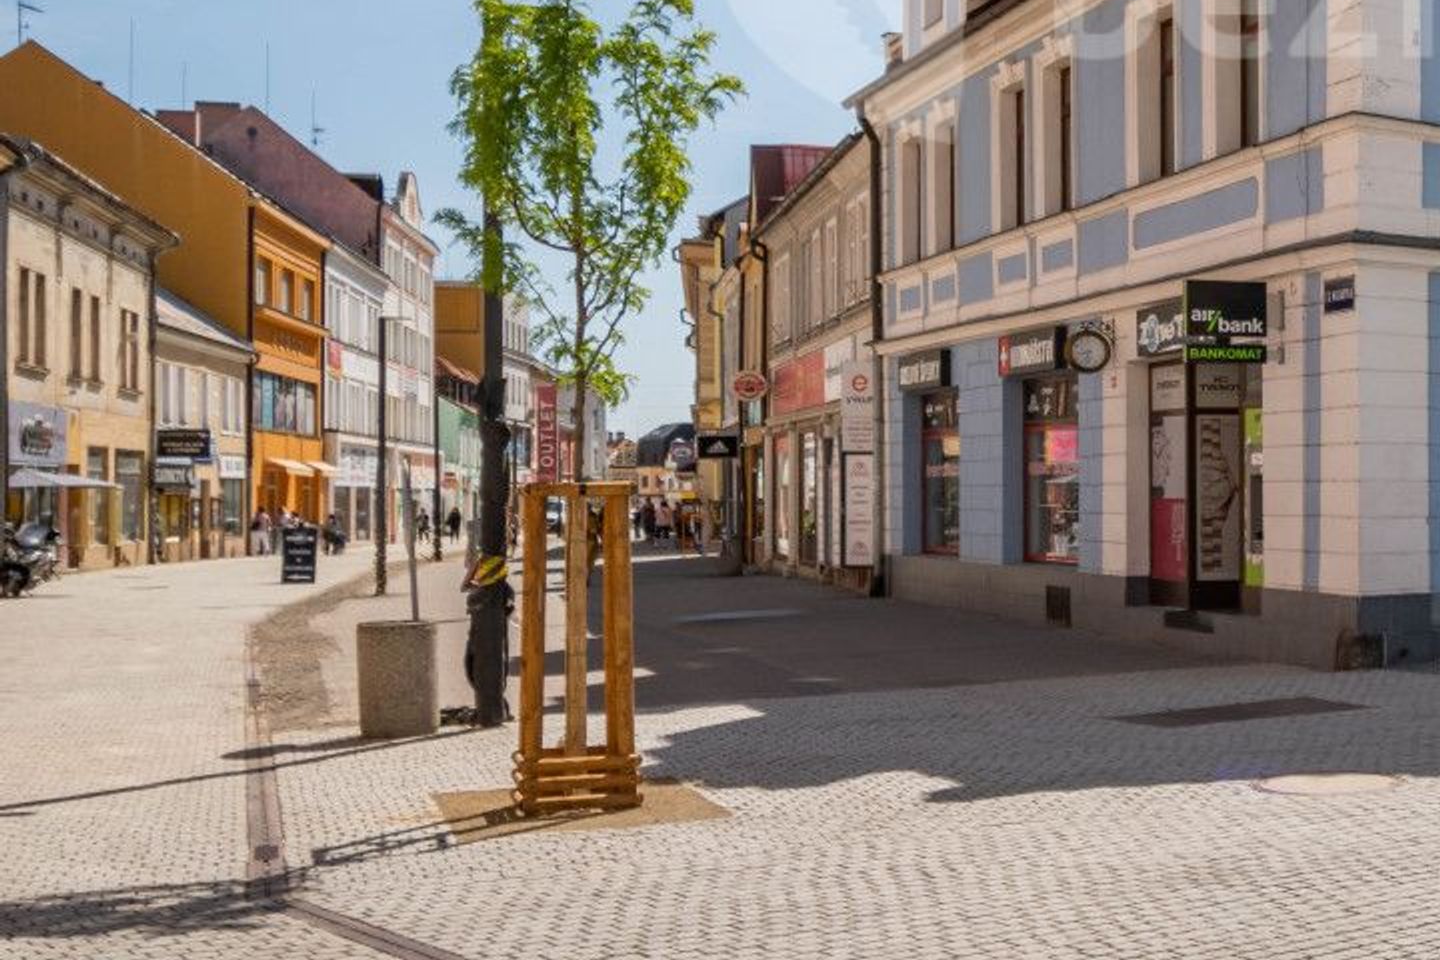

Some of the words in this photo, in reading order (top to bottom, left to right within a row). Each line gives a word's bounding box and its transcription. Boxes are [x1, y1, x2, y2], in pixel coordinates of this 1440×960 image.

[1218, 318, 1263, 333] bank
[1190, 347, 1263, 360] BANKOMAT
[540, 399, 554, 468] OUTLET
